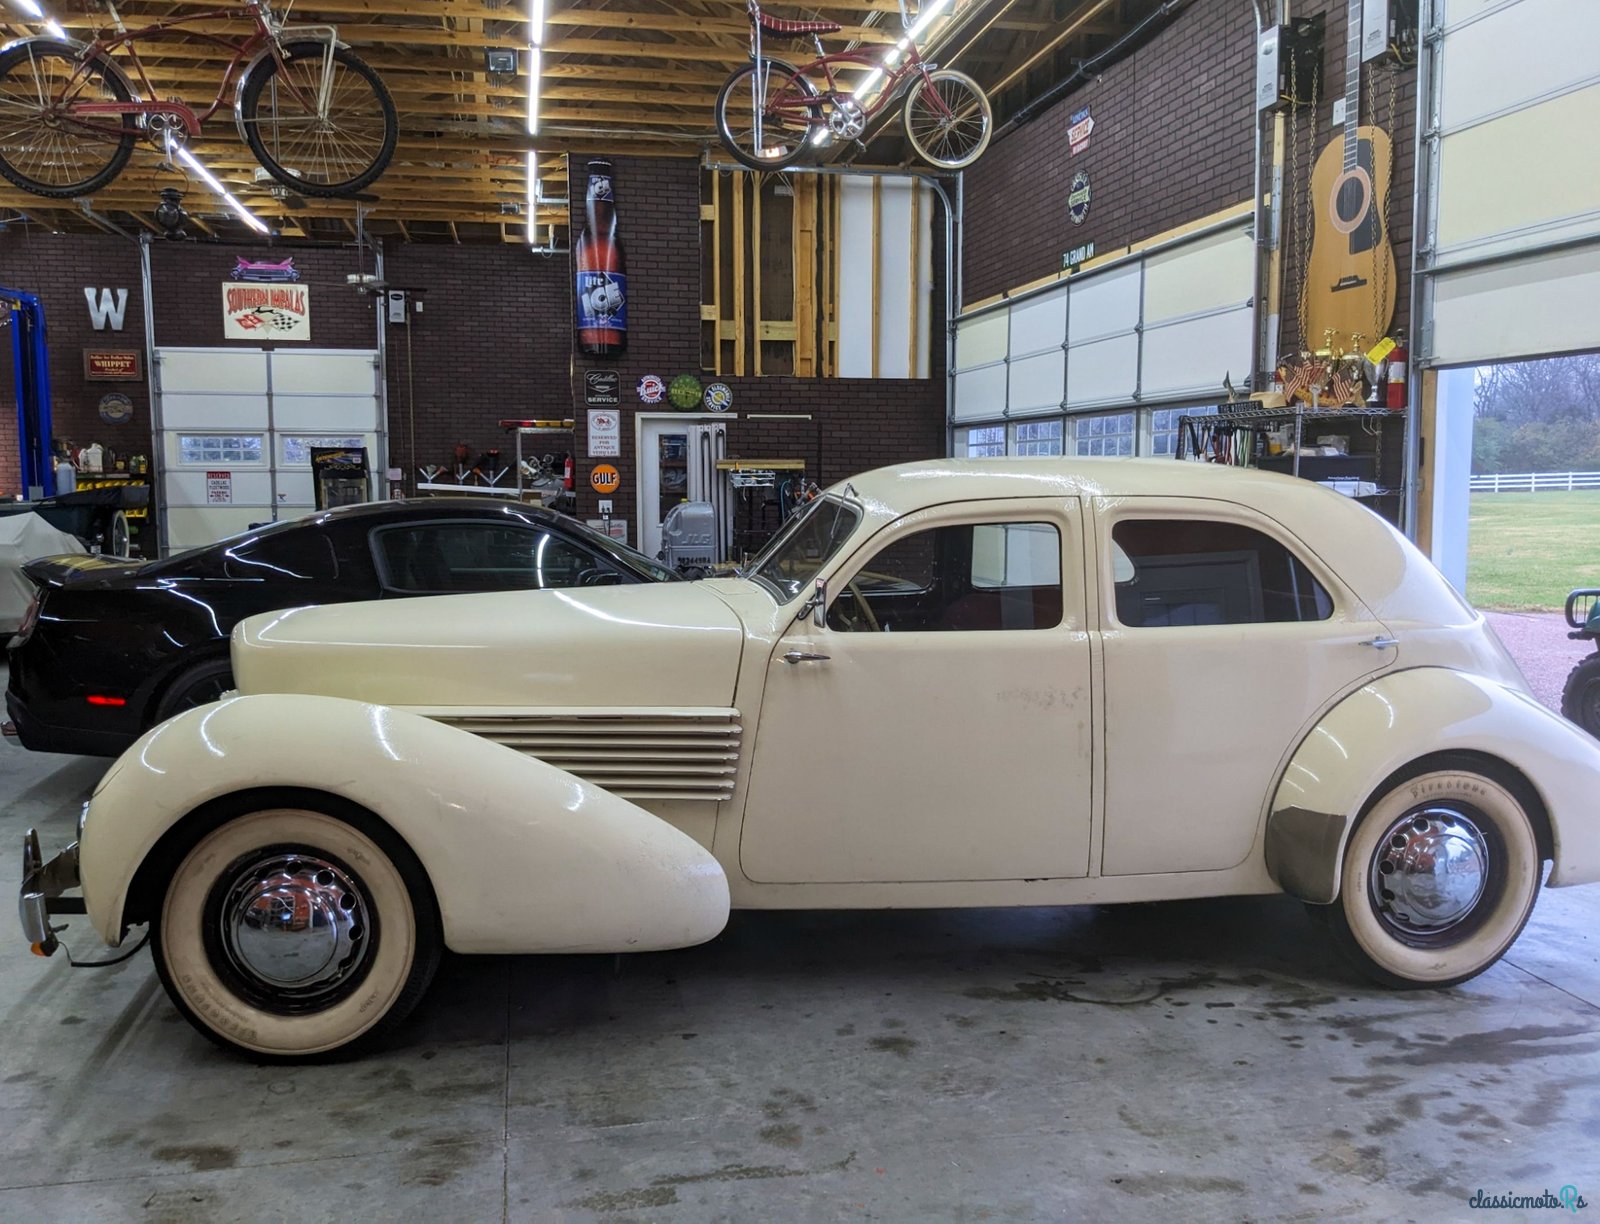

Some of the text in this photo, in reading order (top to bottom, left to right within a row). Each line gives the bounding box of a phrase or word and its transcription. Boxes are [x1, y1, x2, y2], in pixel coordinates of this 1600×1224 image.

[1063, 242, 1094, 268] 74 GRAND AM
[584, 276, 605, 288] Lite
[227, 288, 305, 317] SOUTHERN IMPALAS
[581, 282, 622, 317] ICE
[84, 287, 128, 331] W
[94, 360, 131, 368] WHIPPET
[640, 384, 660, 396] Buick
[640, 395, 662, 404] SERVICE
[592, 473, 617, 485] GULF
